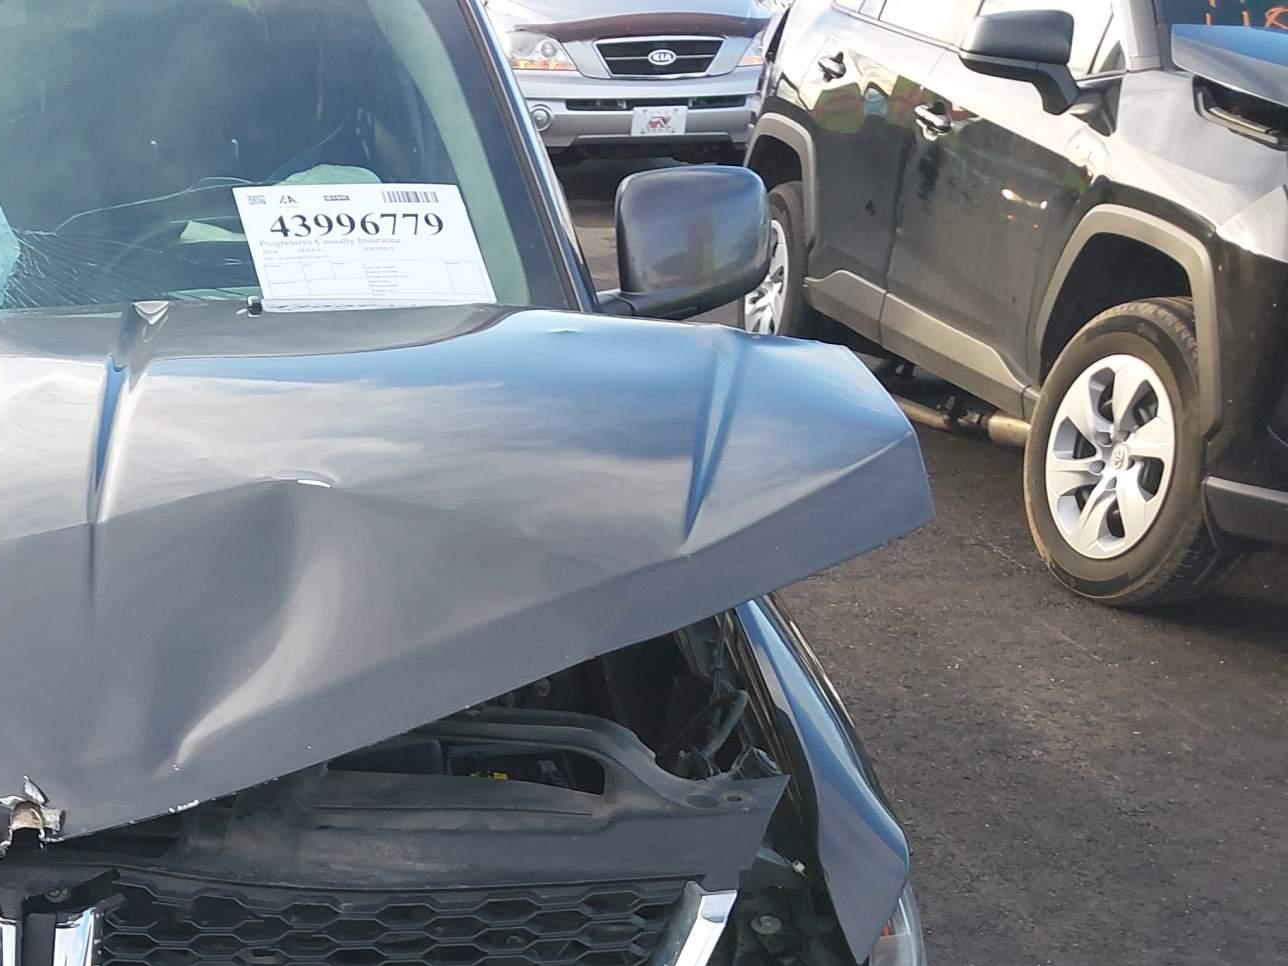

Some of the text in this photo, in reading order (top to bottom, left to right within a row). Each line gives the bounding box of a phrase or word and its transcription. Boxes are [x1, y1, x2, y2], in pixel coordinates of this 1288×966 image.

[652, 52, 673, 61] KIA
[270, 212, 444, 238] 43996779
[259, 238, 313, 249] Progressive
[356, 236, 401, 244] Insurance
